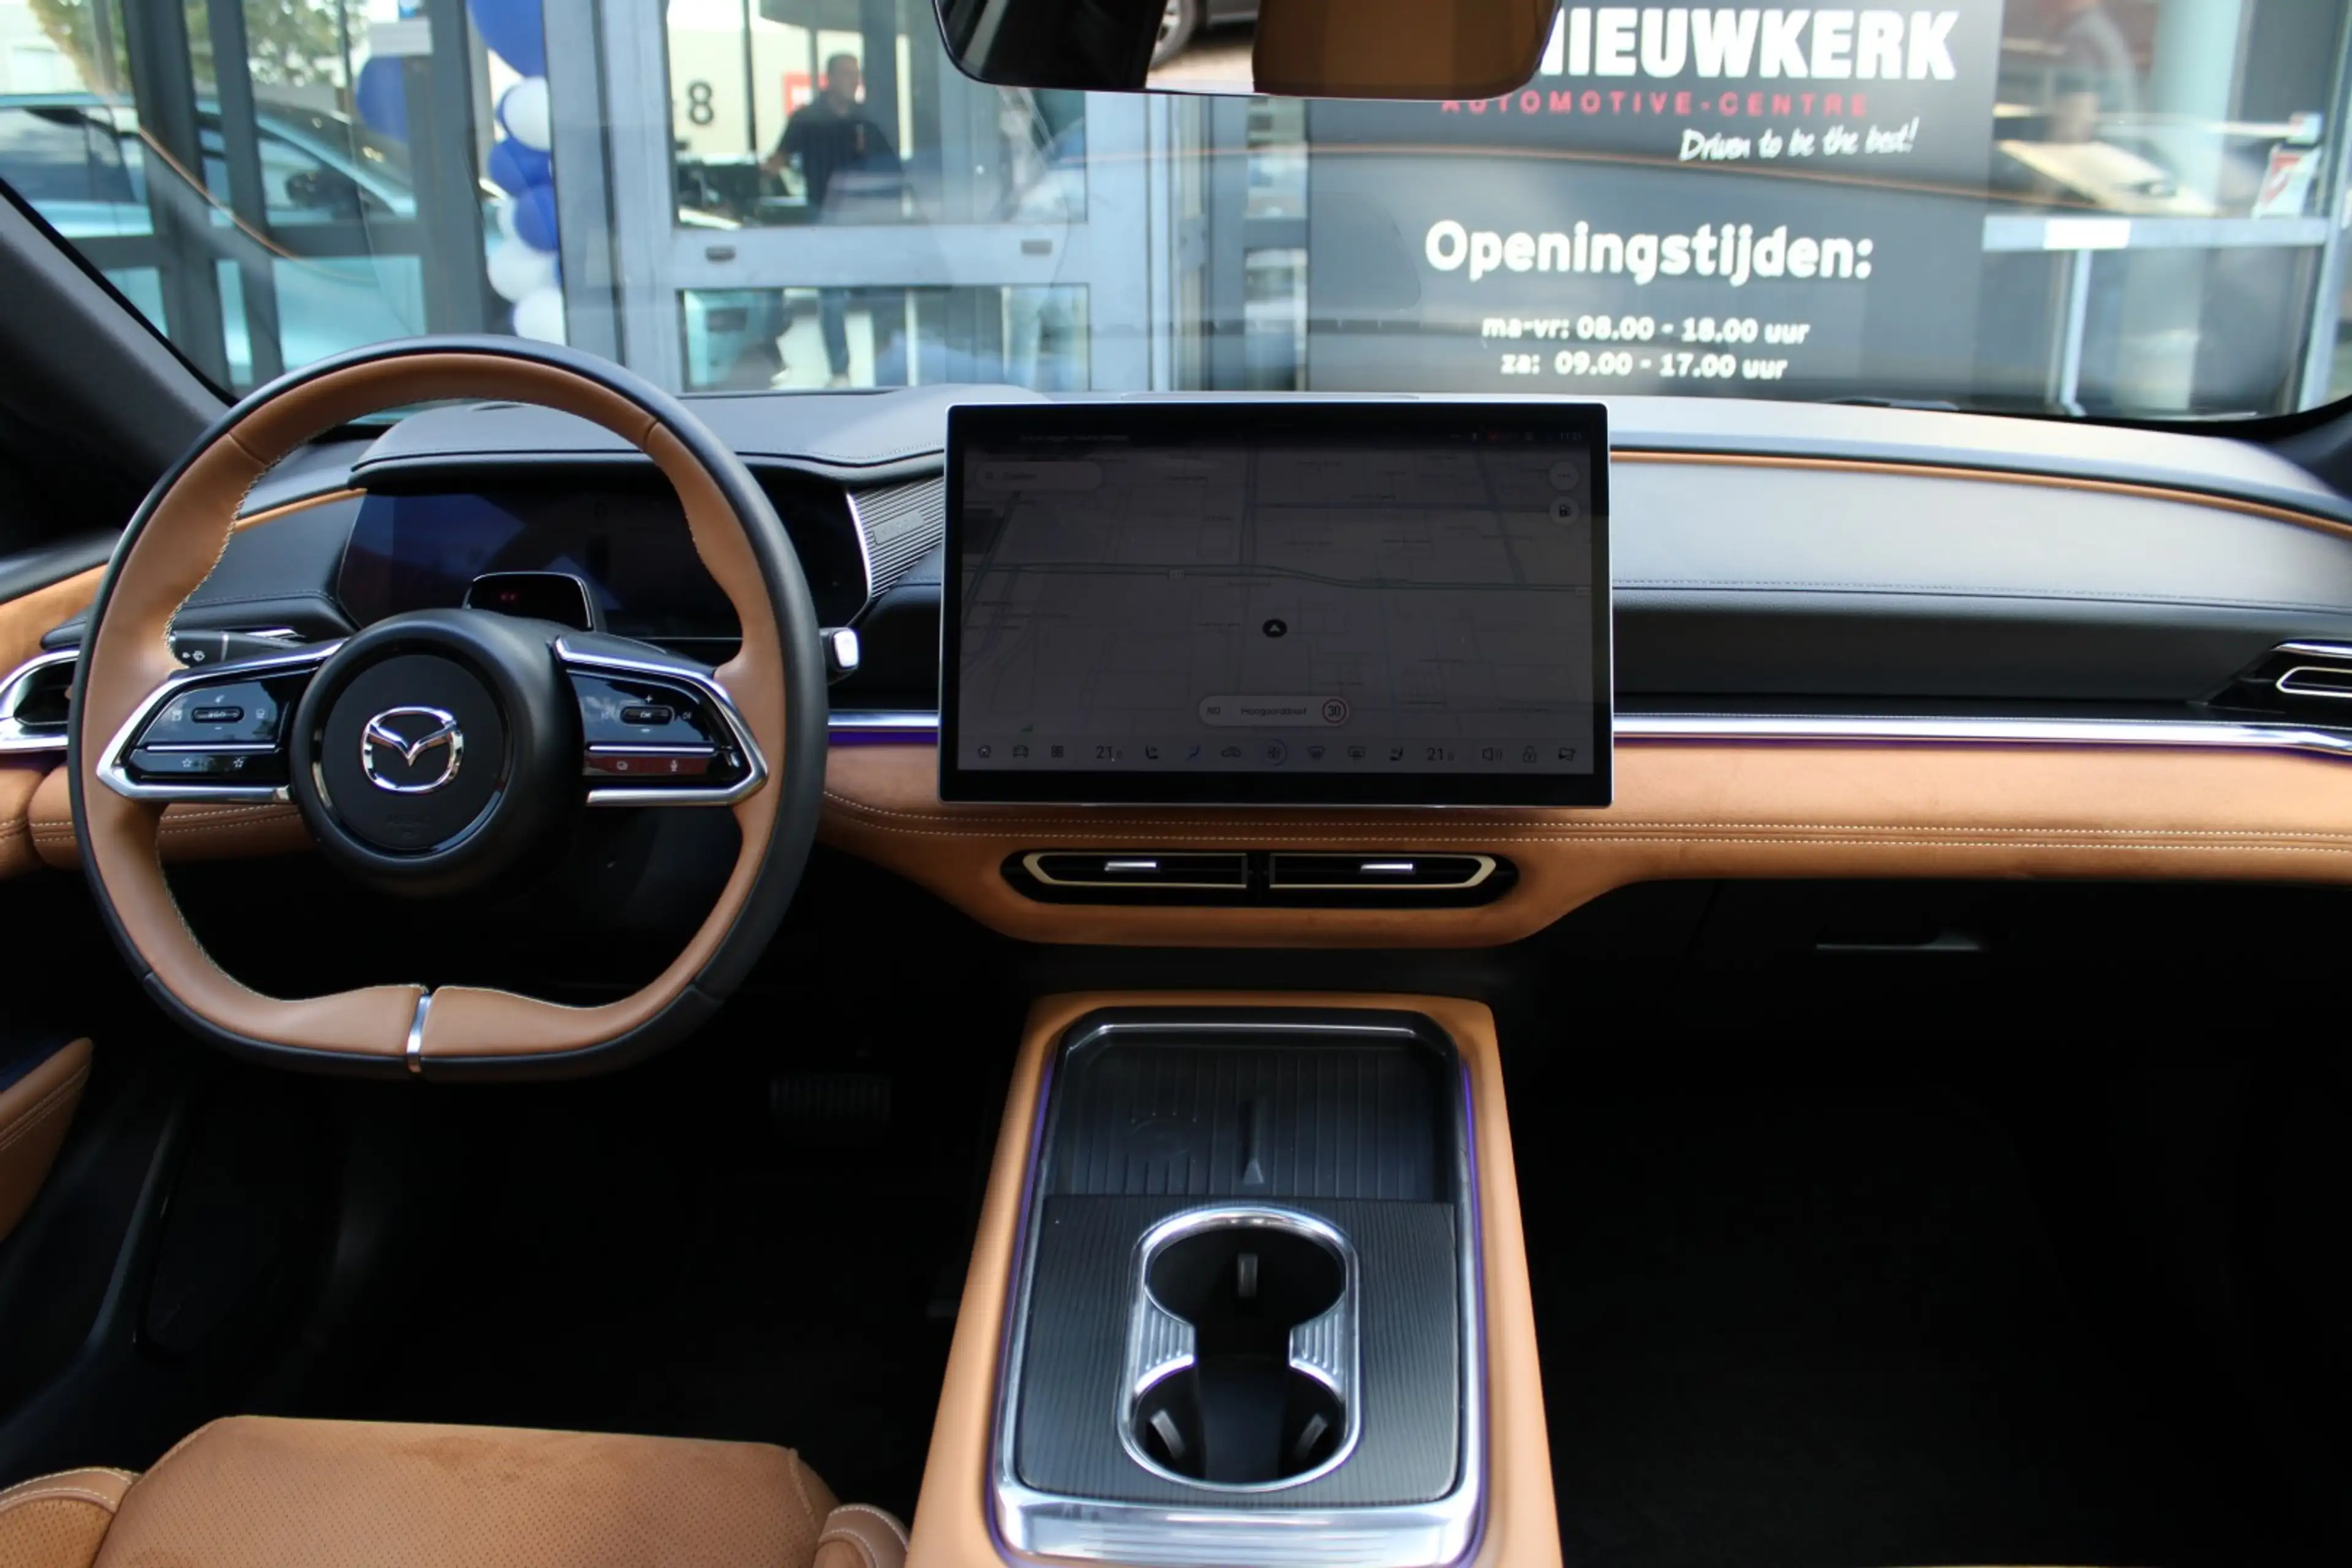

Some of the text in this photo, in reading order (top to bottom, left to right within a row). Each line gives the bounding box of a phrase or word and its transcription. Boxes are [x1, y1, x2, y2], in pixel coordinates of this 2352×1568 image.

[688, 81, 714, 125] 8
[1678, 116, 1920, 161] Driven to be the best!
[1425, 219, 1874, 287] Openingstijden:
[1482, 317, 1570, 339] ma-vr:
[1576, 314, 1655, 342] 08.00
[1681, 316, 1758, 344] 18.00
[1763, 323, 1811, 344] uur
[1501, 353, 1541, 375] za:
[1553, 350, 1634, 377] 09.00
[1659, 352, 1737, 379] 17.00
[1742, 358, 1789, 380] uur
